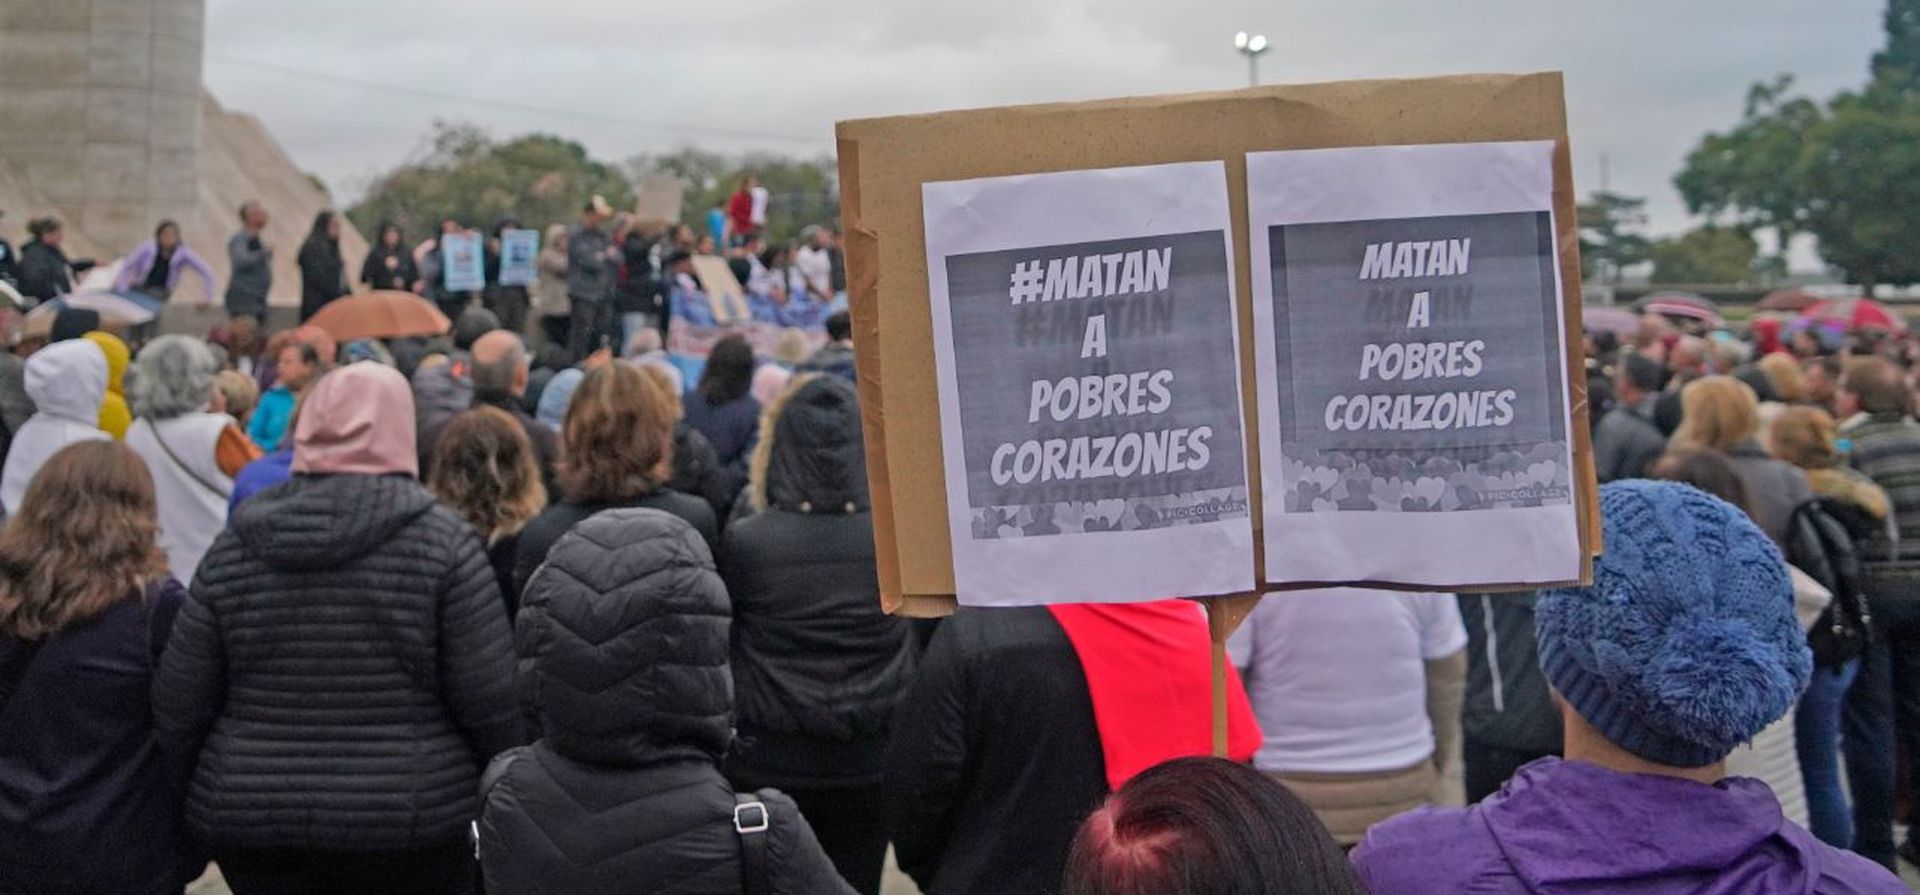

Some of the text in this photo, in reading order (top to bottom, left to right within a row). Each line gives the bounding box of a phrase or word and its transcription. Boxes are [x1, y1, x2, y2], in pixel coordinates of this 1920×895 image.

[1010, 248, 1172, 304] #MATAN
[1360, 238, 1470, 279] MATAN
[1407, 292, 1430, 329] A
[1081, 315, 1106, 358] A
[1360, 340, 1484, 380] POBRES
[1029, 370, 1173, 423] POBRES
[1324, 389, 1516, 431] CORAZONES
[991, 427, 1212, 485] CORAZONES
